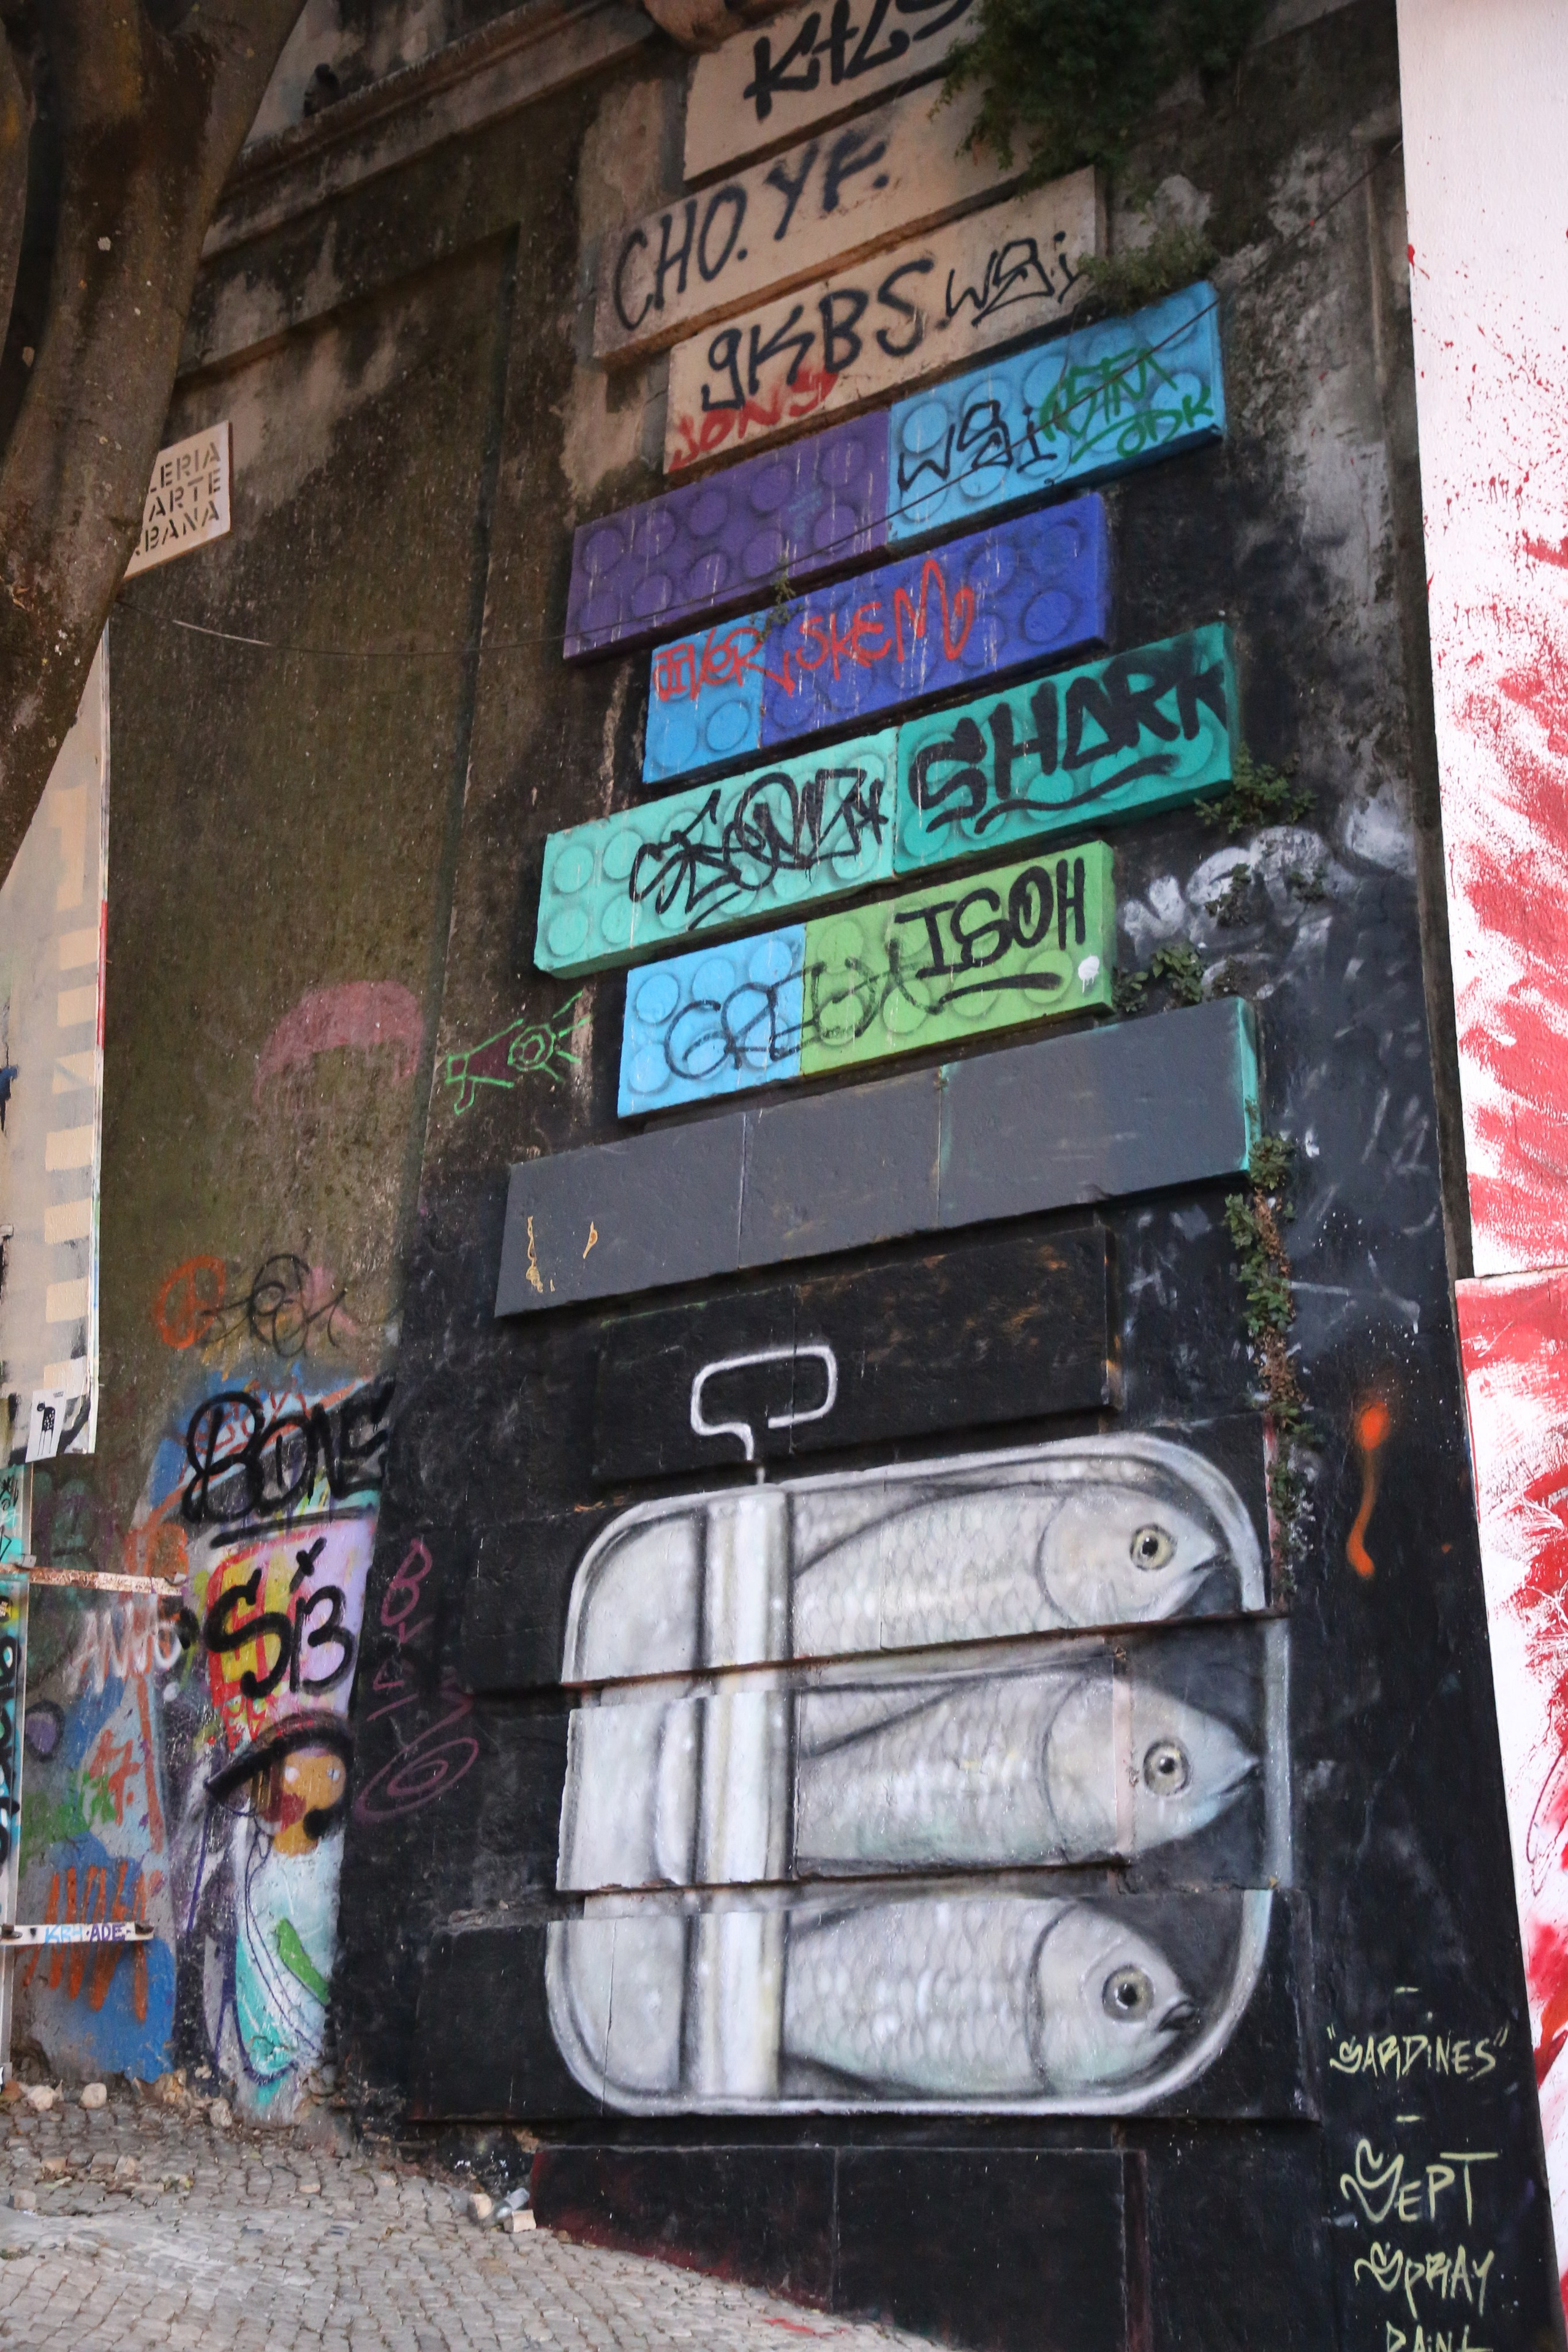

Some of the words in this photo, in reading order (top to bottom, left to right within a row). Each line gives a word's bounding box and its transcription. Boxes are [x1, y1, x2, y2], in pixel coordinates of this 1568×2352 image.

[150, 441, 221, 493] ERIA
[148, 468, 221, 522] ARTE
[135, 500, 219, 556] BANA
